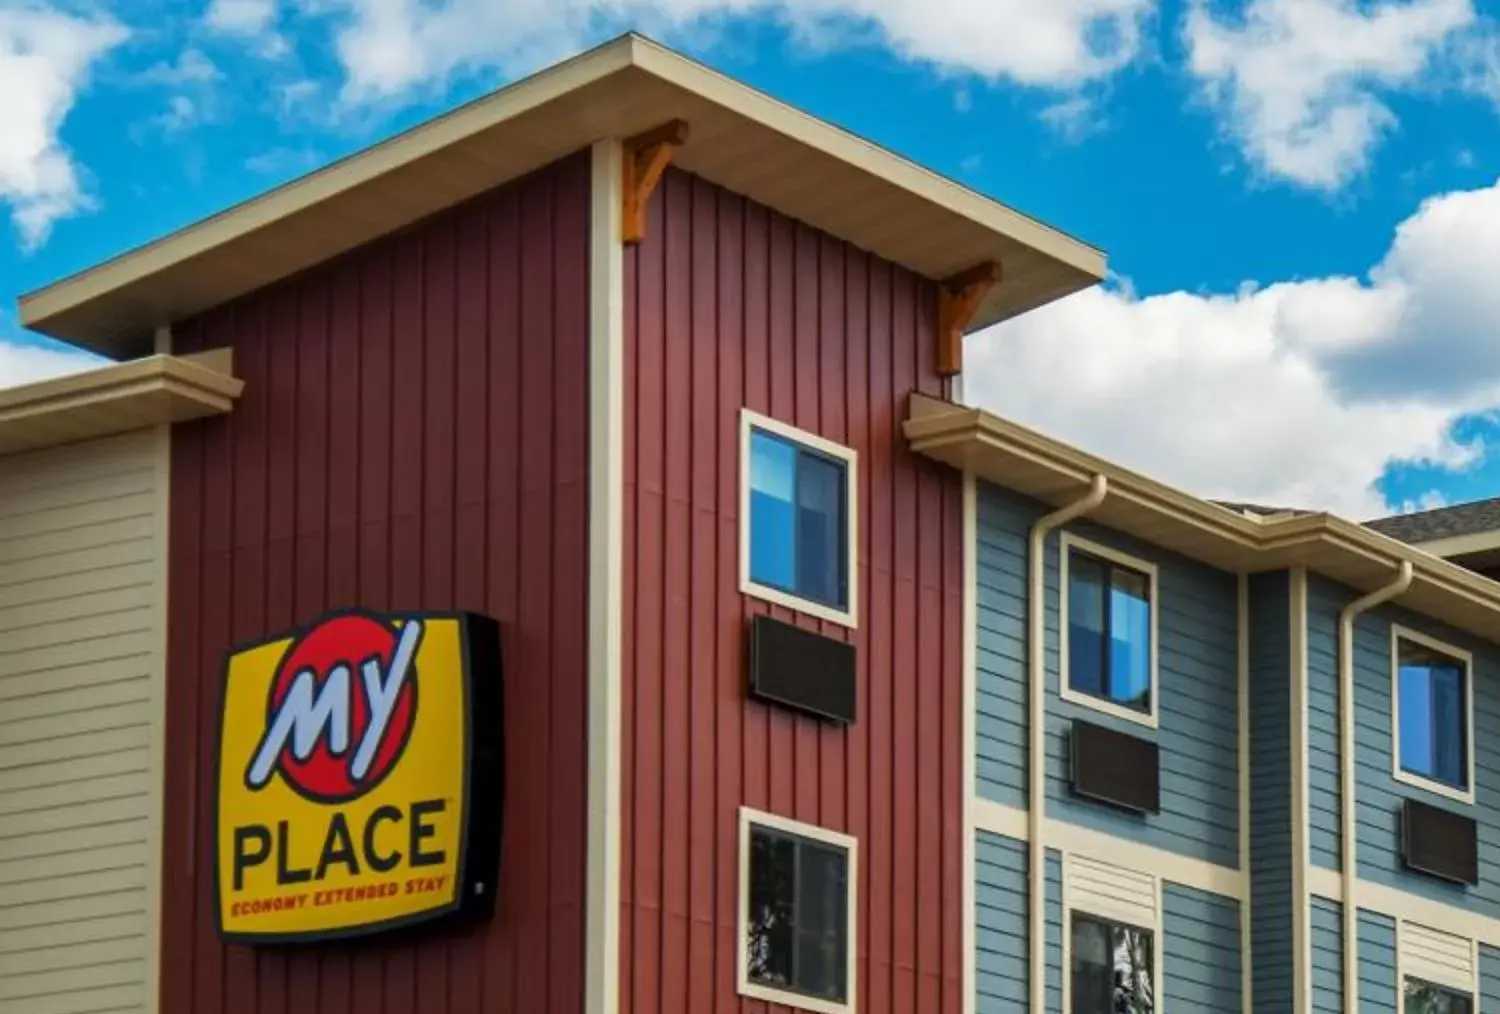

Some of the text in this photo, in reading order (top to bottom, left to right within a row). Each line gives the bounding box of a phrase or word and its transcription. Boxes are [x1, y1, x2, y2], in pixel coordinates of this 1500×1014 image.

[232, 798, 446, 892] PLACE
[231, 875, 446, 917] ECONOMY EXTENDED STAY
